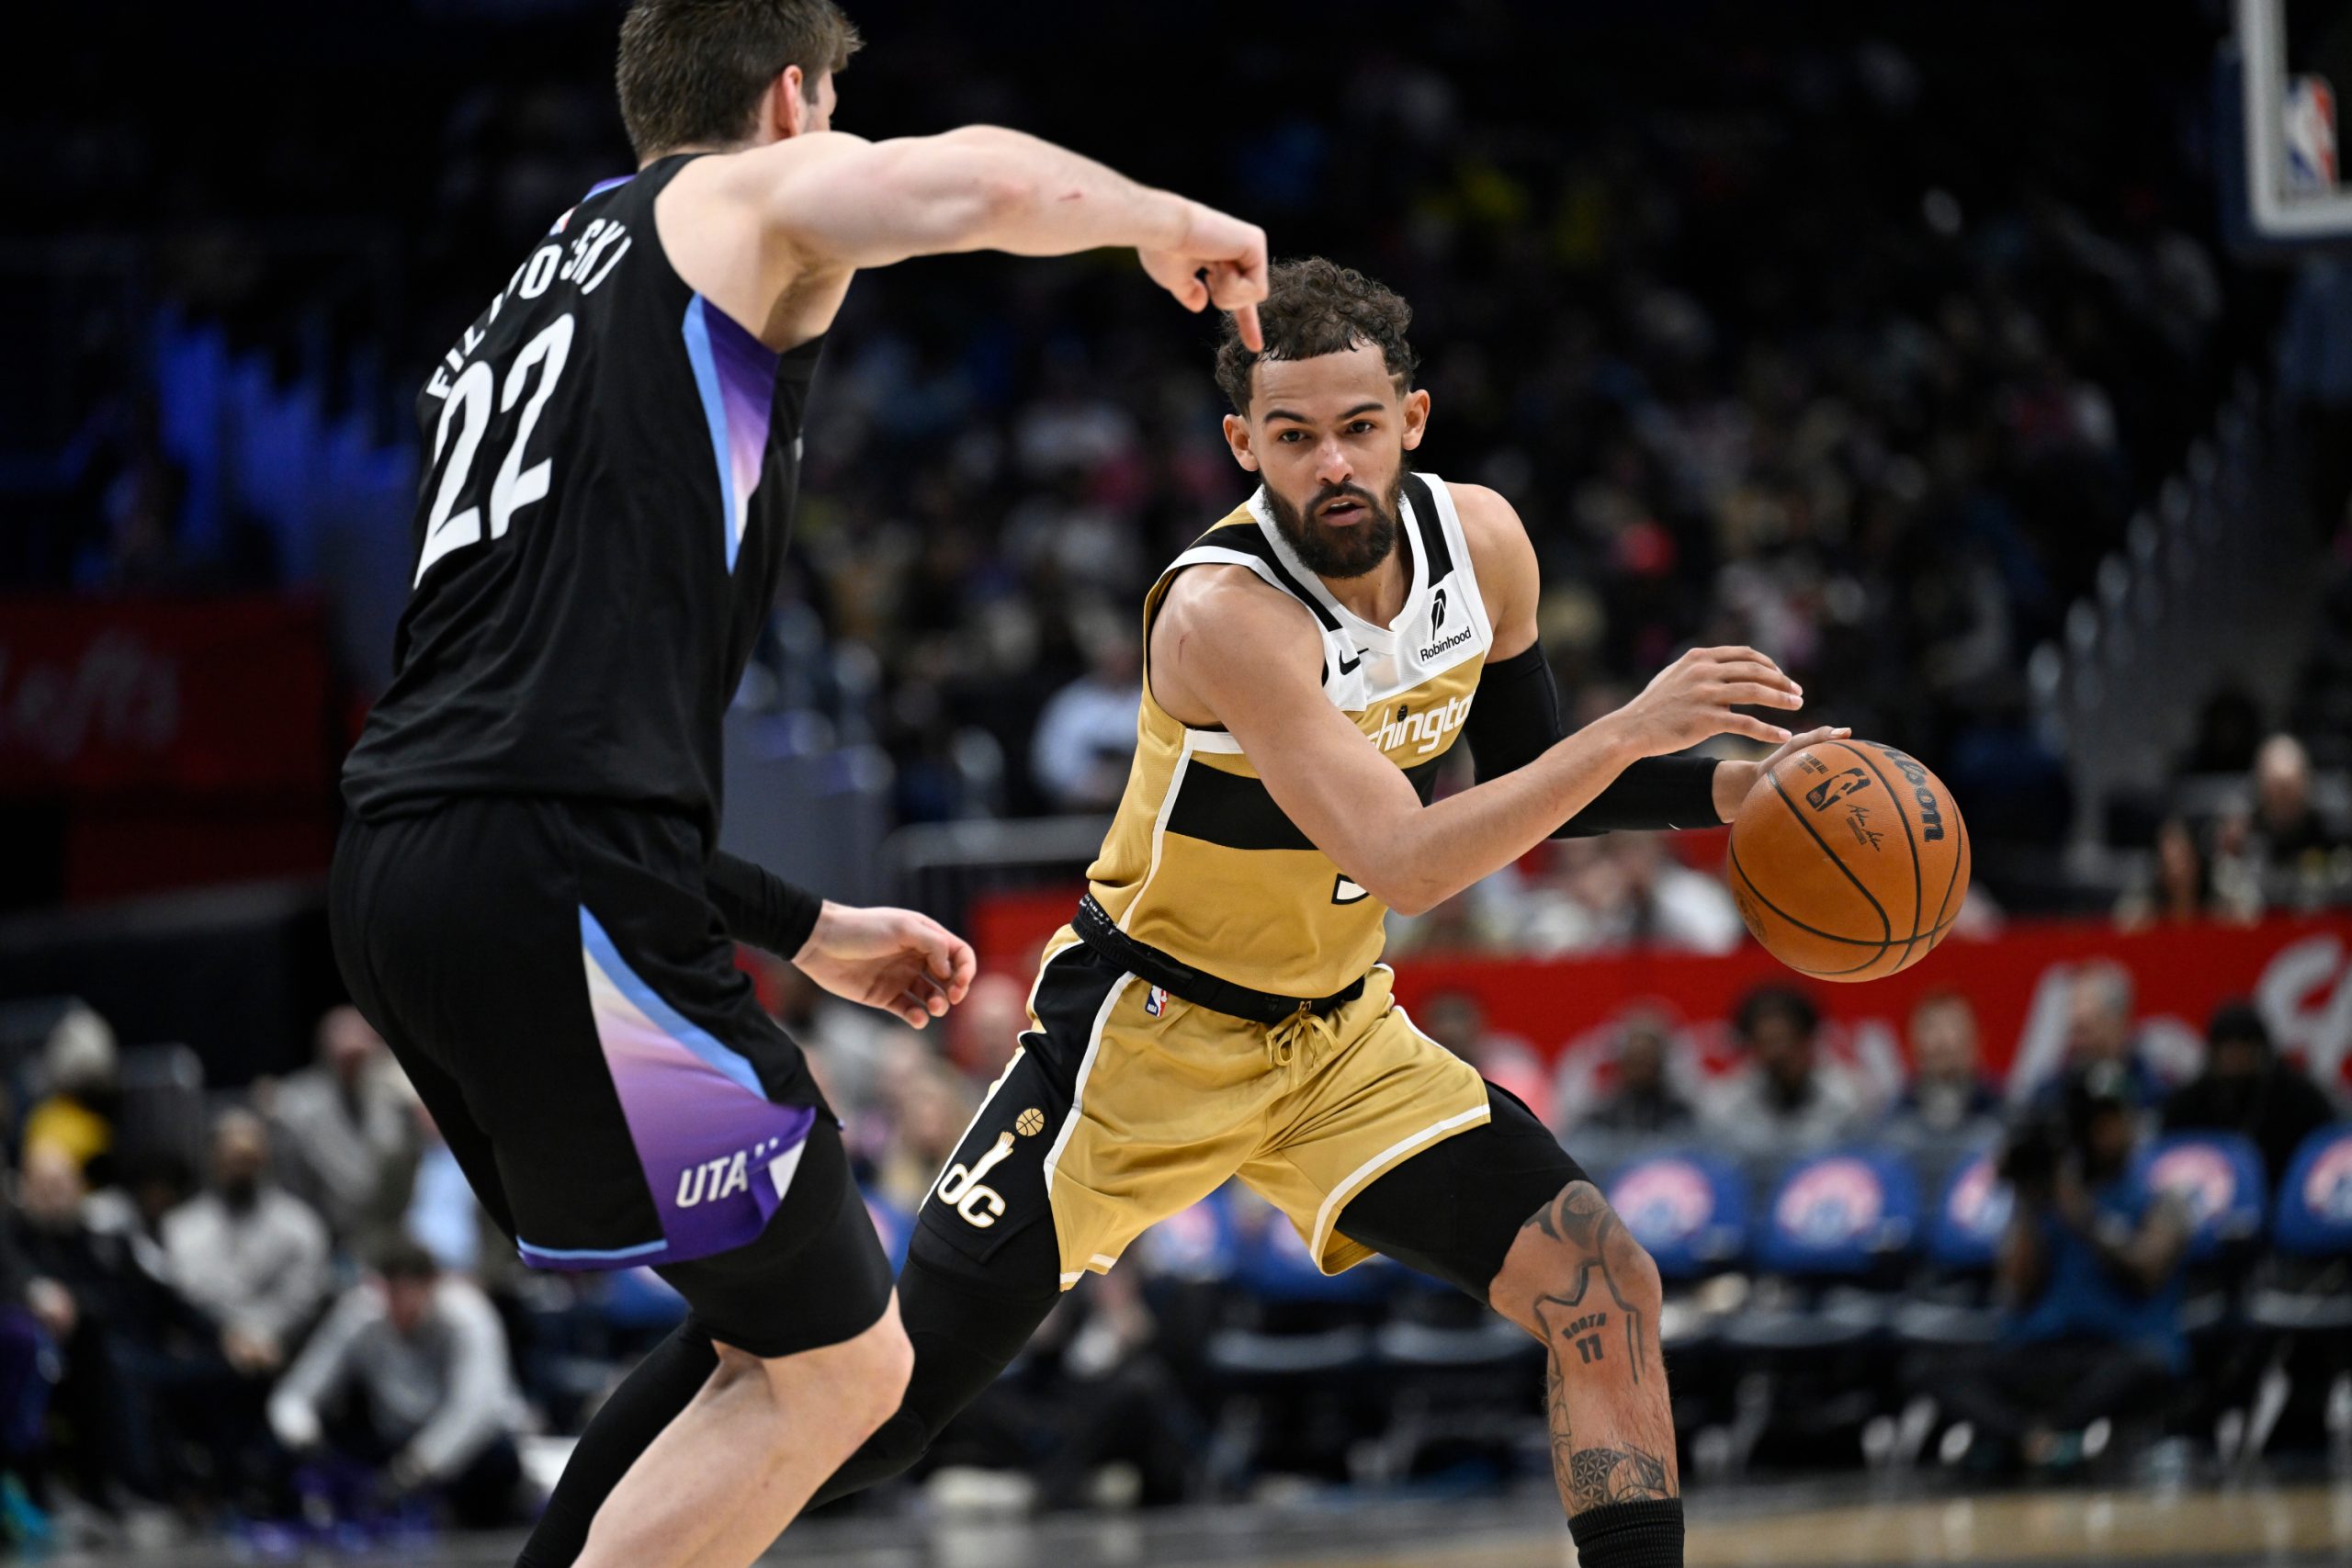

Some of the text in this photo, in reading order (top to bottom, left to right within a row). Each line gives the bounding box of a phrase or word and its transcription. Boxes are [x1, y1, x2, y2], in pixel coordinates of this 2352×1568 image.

[413, 312, 576, 591] 22
[1419, 626, 1472, 662] Robinhood
[675, 1136, 780, 1209] UTA
[1576, 1333, 1604, 1365] 11
